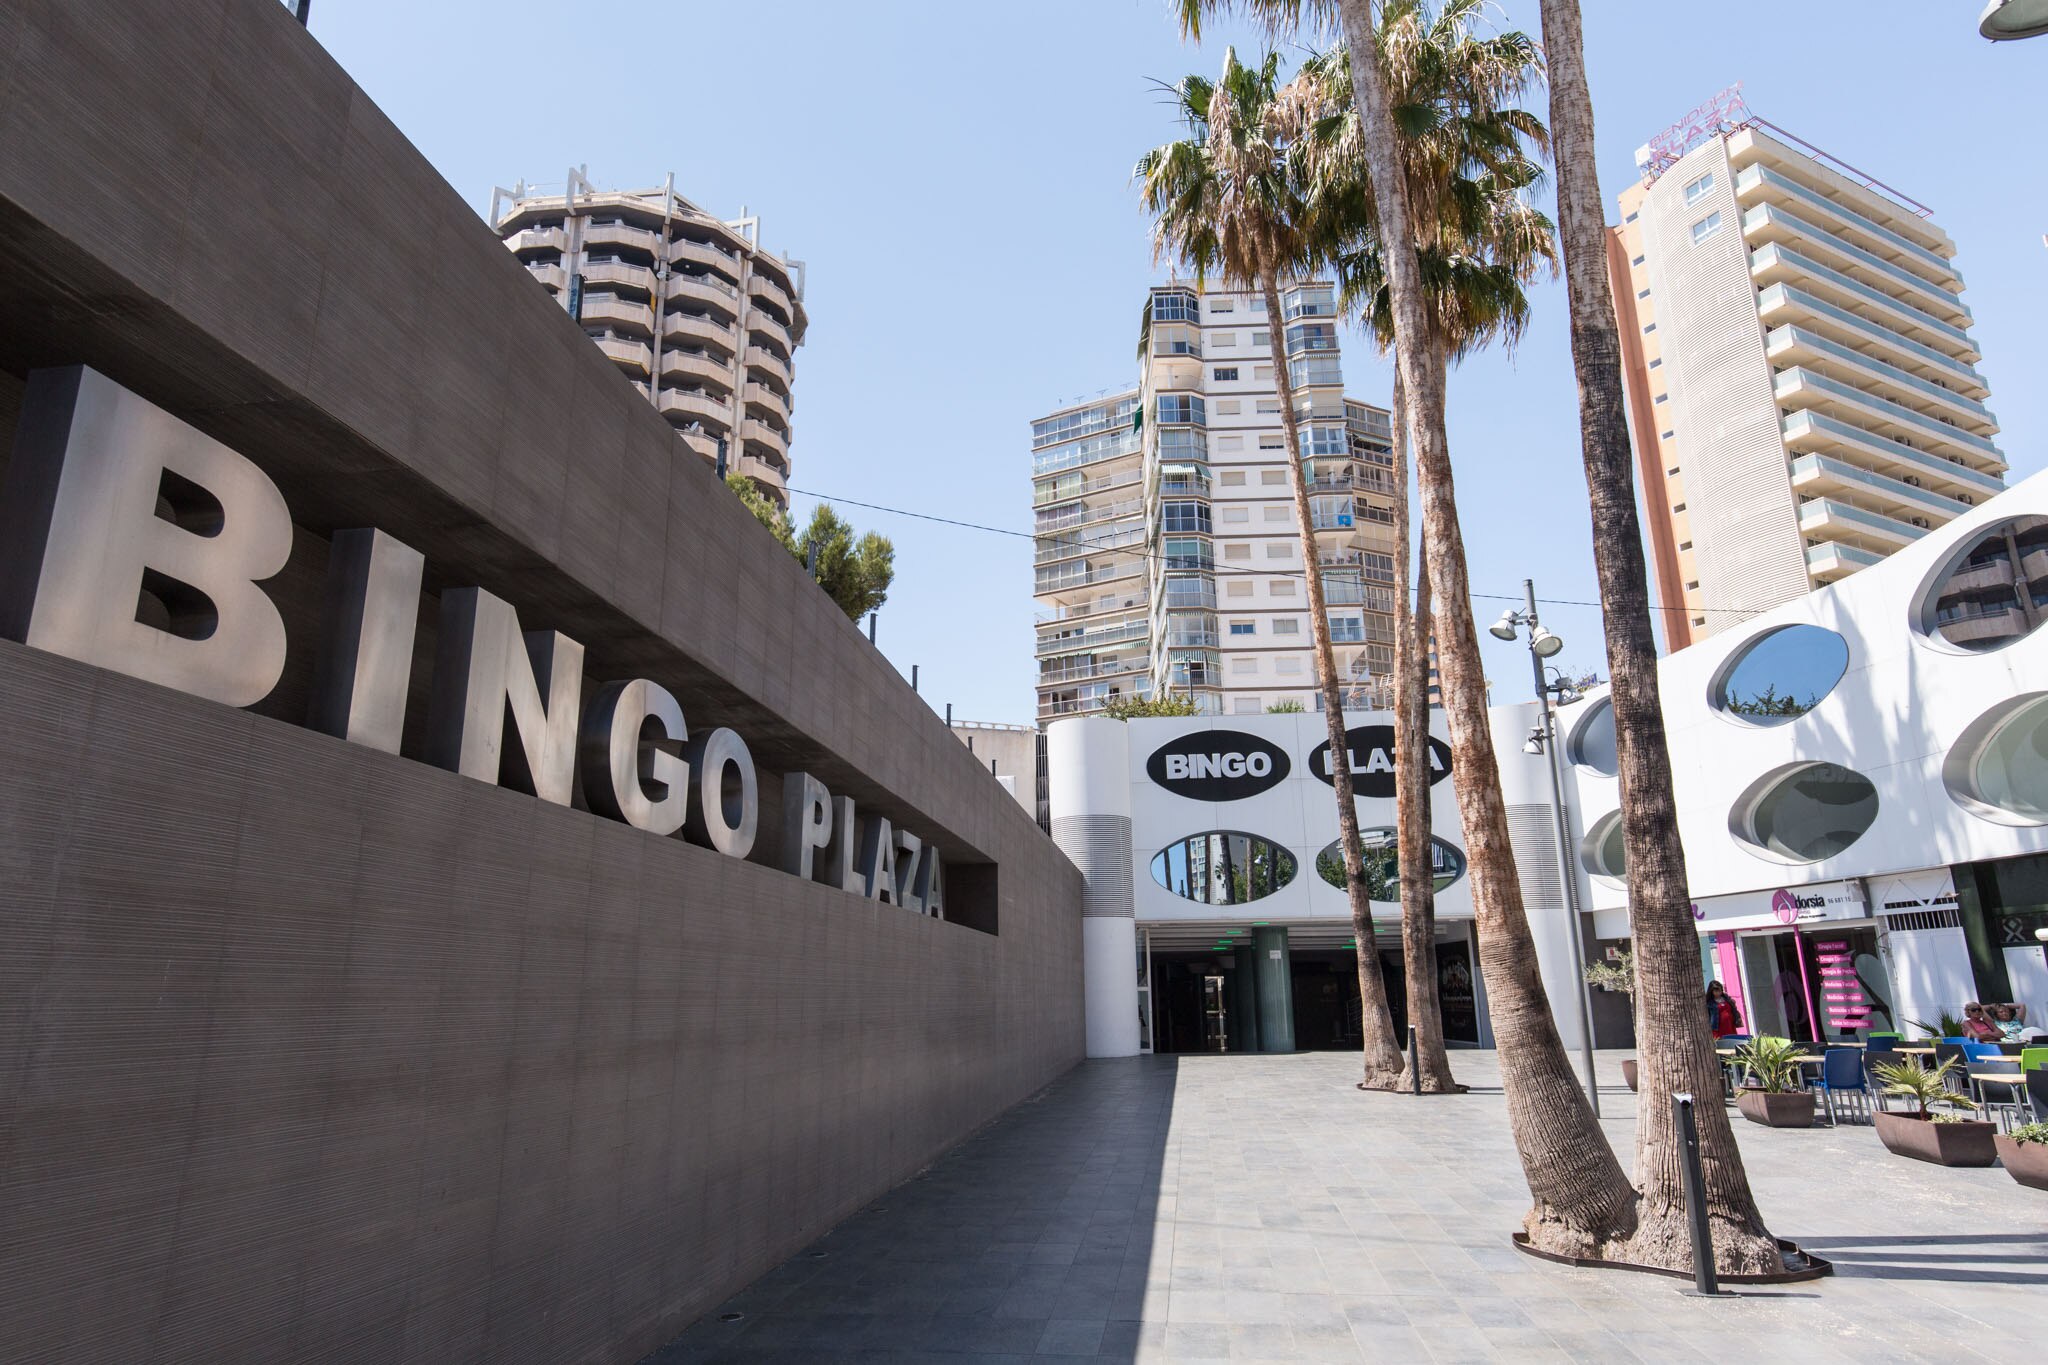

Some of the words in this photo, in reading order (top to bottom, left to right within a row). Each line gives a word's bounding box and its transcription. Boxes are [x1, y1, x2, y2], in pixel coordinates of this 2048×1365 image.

[1652, 97, 1743, 162] PLAZA
[24, 363, 758, 859] BINGO
[786, 772, 944, 920] PLAZA
[1165, 751, 1273, 780] BINGO
[1795, 894, 1825, 909] dorsia
